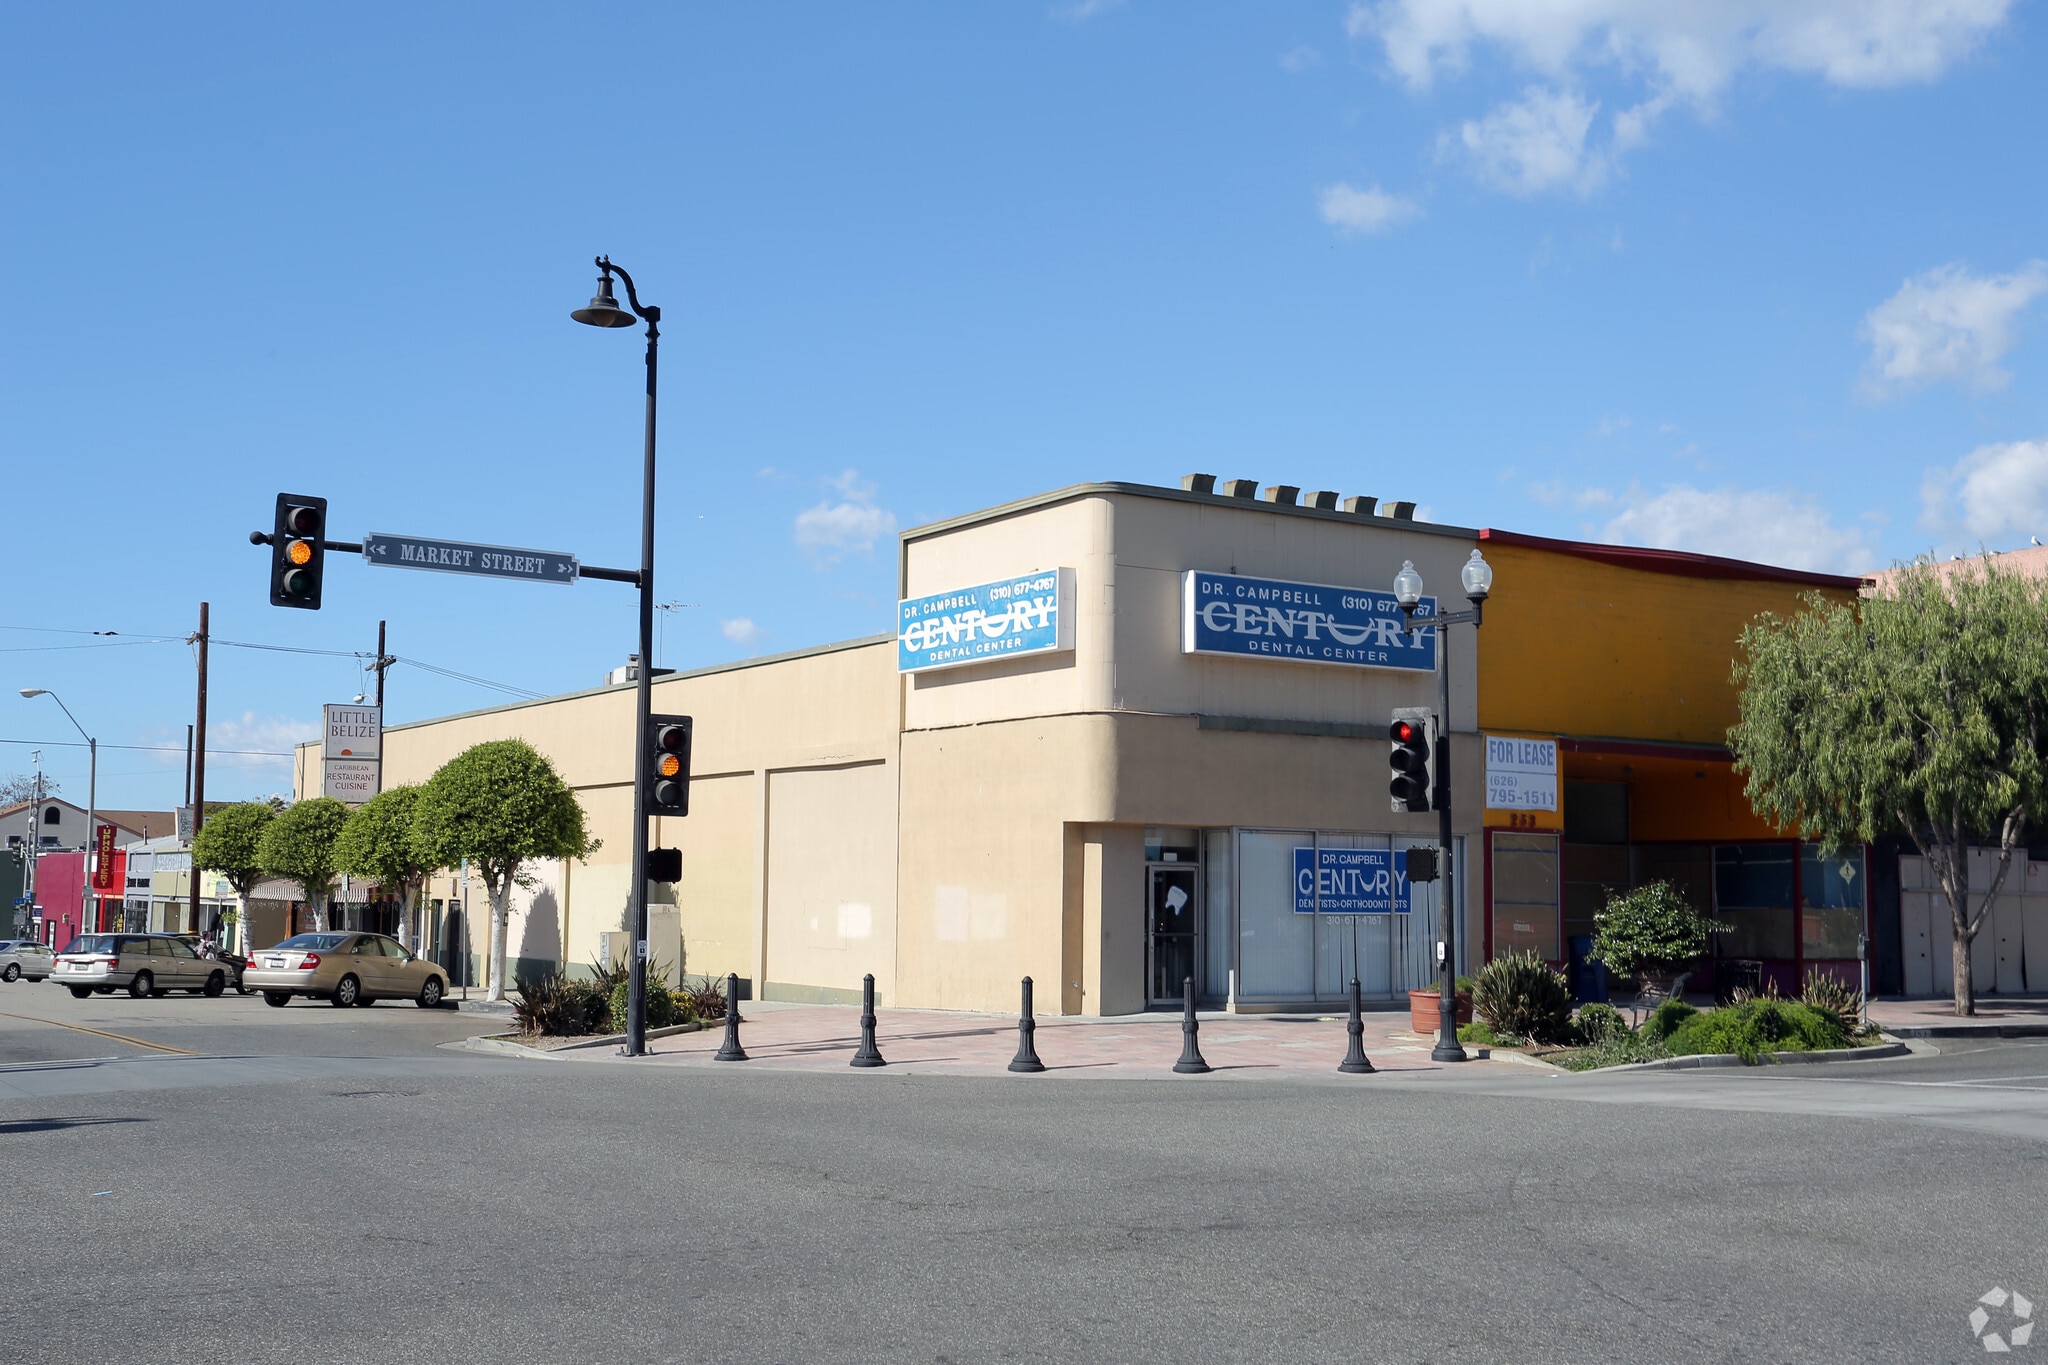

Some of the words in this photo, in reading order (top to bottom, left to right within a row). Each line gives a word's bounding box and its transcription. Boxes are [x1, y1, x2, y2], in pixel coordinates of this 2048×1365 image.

[400, 543, 473, 567] MARKET
[481, 552, 546, 574] STREET
[904, 606, 921, 619] DR.
[923, 593, 977, 614] CAMPBELL
[989, 584, 1012, 602] (310)
[1013, 576, 1056, 597] 677-4767
[1202, 581, 1230, 597] DR.
[1236, 585, 1322, 606] CAMPBELL
[1342, 595, 1373, 612] (310)
[904, 595, 1056, 653] CENTURY
[1202, 601, 1428, 650] CENTURY
[930, 645, 971, 662] DENTAL
[976, 637, 1022, 653] CENTER
[1249, 640, 1315, 656] DENTAL
[1323, 647, 1389, 662] CENTER
[332, 711, 376, 724] LITTLE
[331, 725, 375, 738] BELIZE
[1489, 740, 1514, 764] FOR
[1518, 742, 1554, 766] LEASE
[327, 772, 375, 781] RESTAURANT
[334, 764, 369, 772] CARIBBEAN
[335, 782, 368, 790] CUISINE
[1490, 775, 1517, 787] (626)
[1489, 788, 1554, 806] 795-1511
[100, 828, 111, 887] UPHOLSTERY
[1322, 854, 1338, 864] DR.
[1339, 854, 1385, 865] CAMPBELL
[1298, 868, 1407, 896] CENTURY
